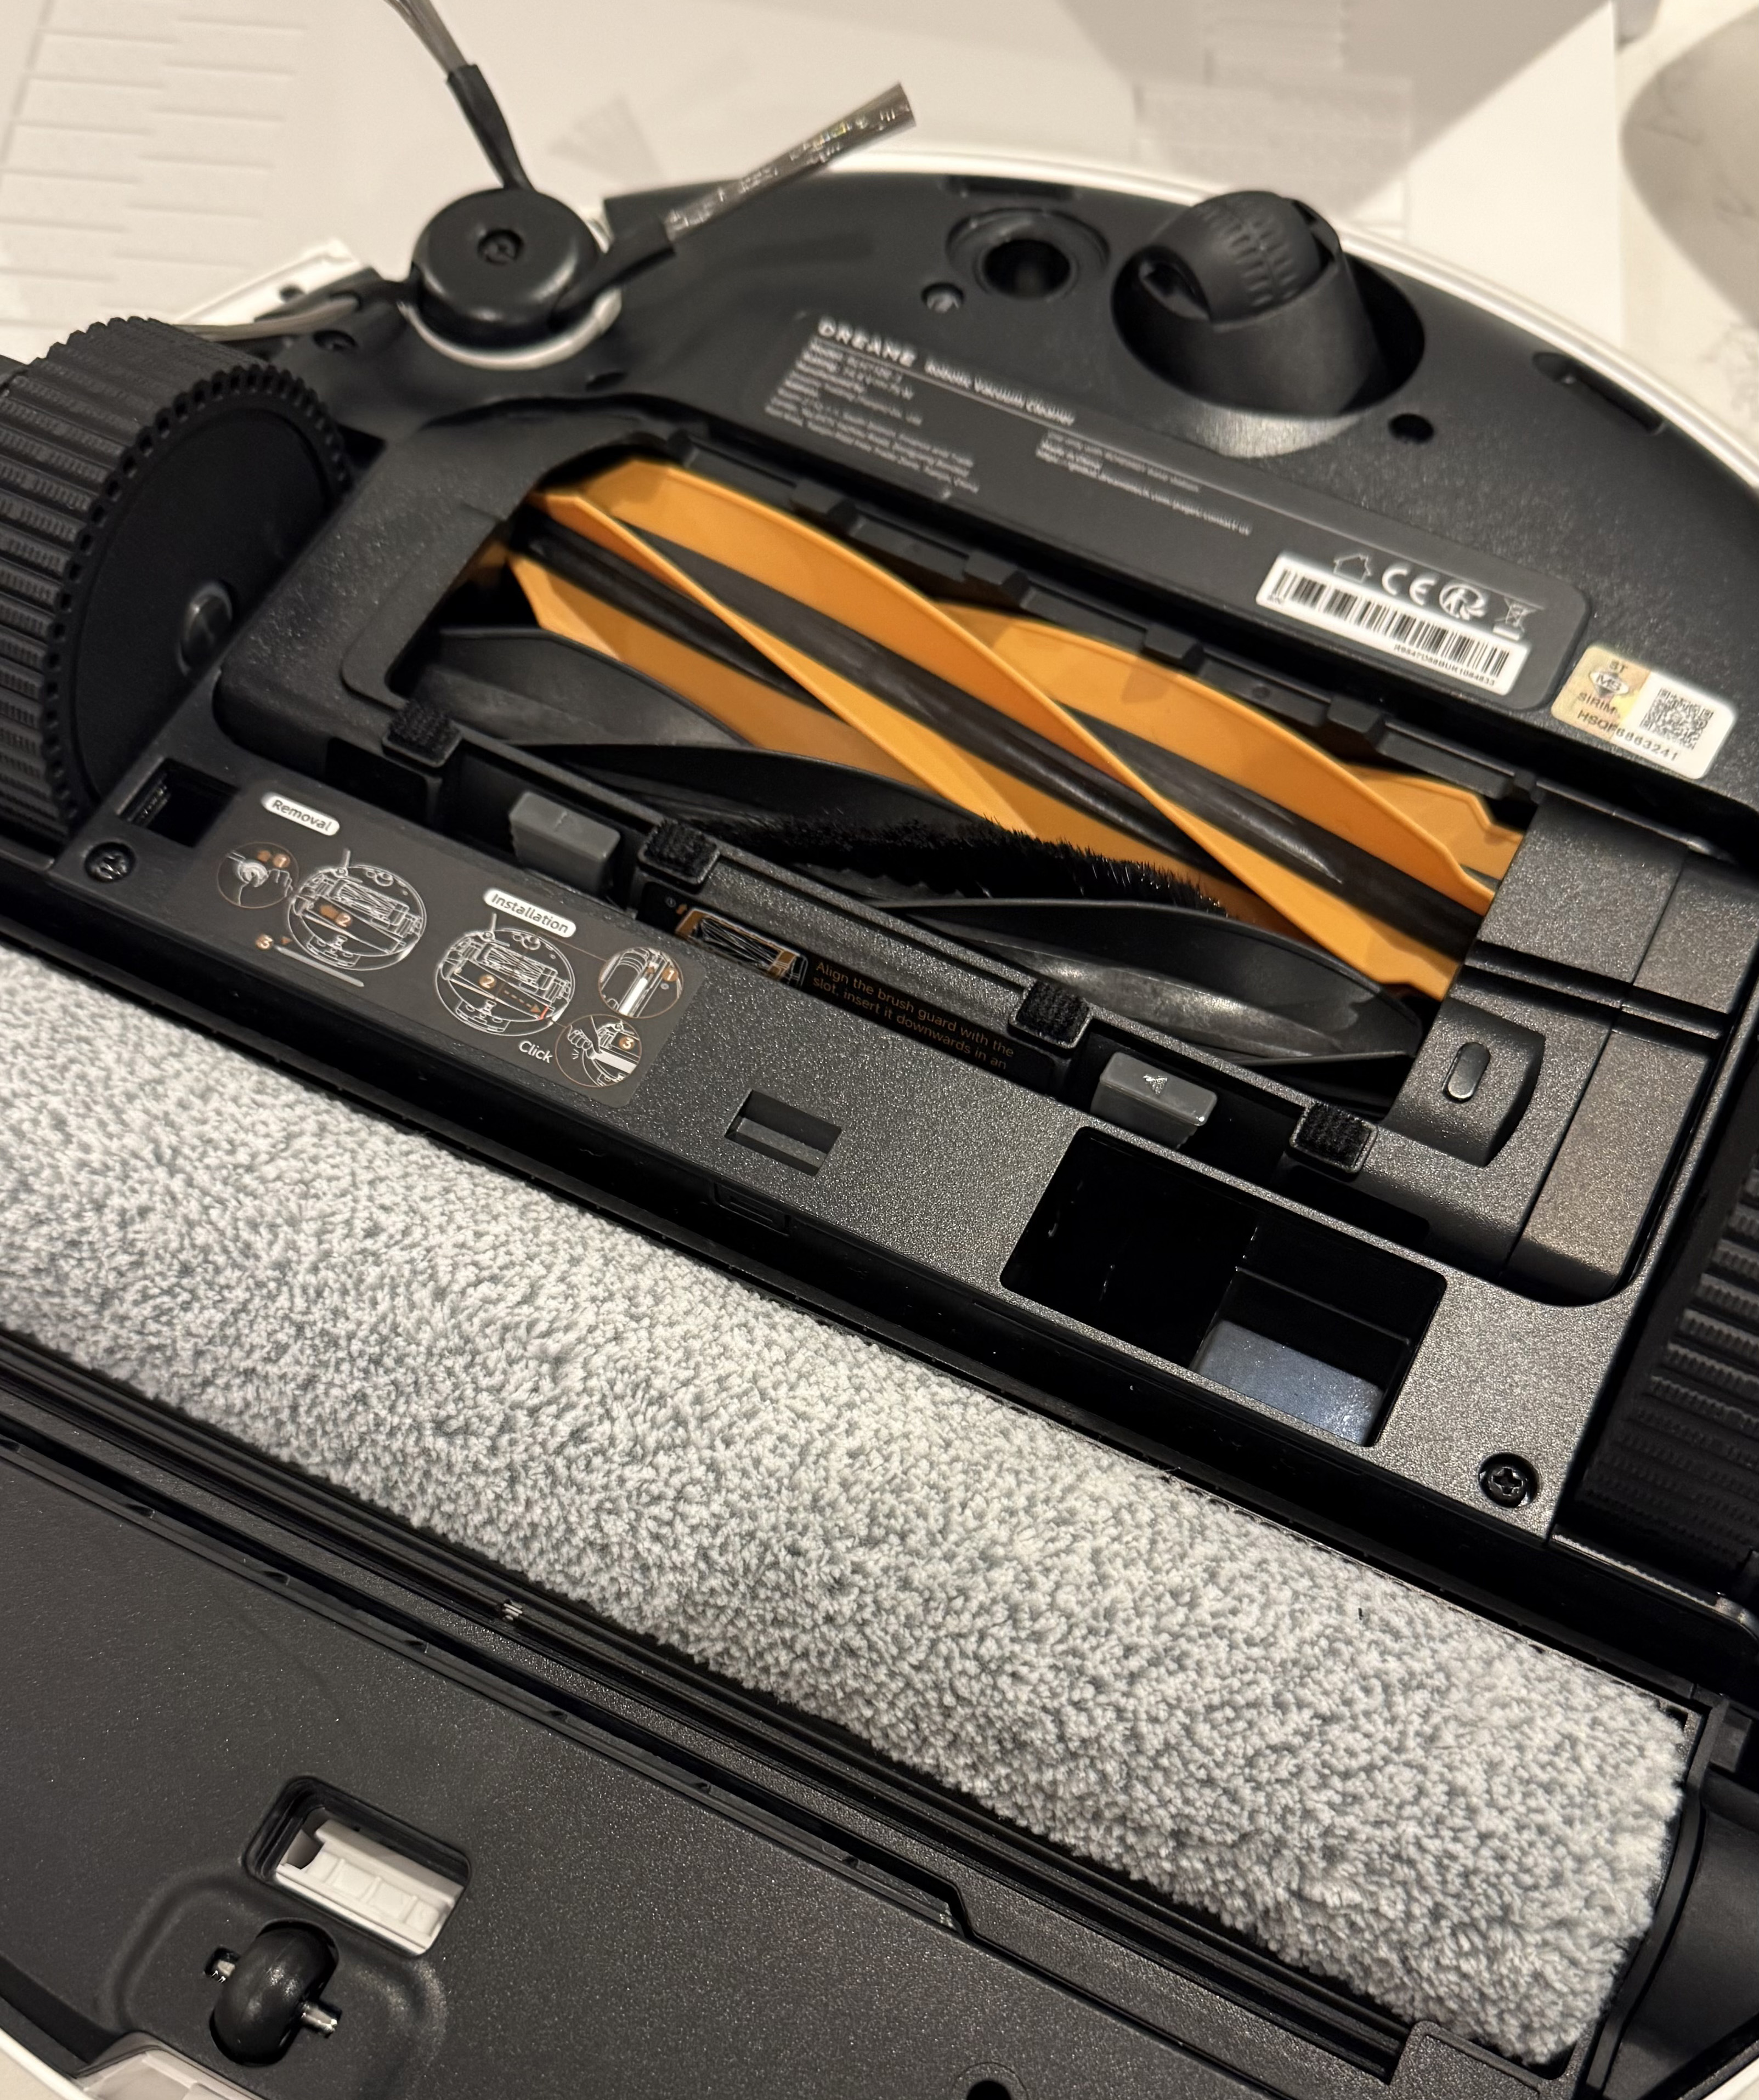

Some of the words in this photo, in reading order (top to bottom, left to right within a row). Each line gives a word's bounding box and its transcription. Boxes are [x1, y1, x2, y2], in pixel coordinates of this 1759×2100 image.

[1609, 659, 1628, 673] ST
[1595, 673, 1622, 692] MS
[272, 799, 332, 831] Removal
[491, 893, 569, 934] Installation
[816, 961, 849, 985] Align
[853, 977, 874, 995] the
[878, 988, 914, 1014] brush
[918, 1009, 957, 1032] guard
[960, 1027, 989, 1046] with
[993, 1040, 1014, 1057] the
[843, 988, 881, 1015] insert
[884, 1006, 893, 1020] it
[896, 1014, 971, 1054] downwards
[975, 1047, 987, 1061] in
[989, 1056, 1007, 1070] an
[518, 1040, 553, 1063] Click
